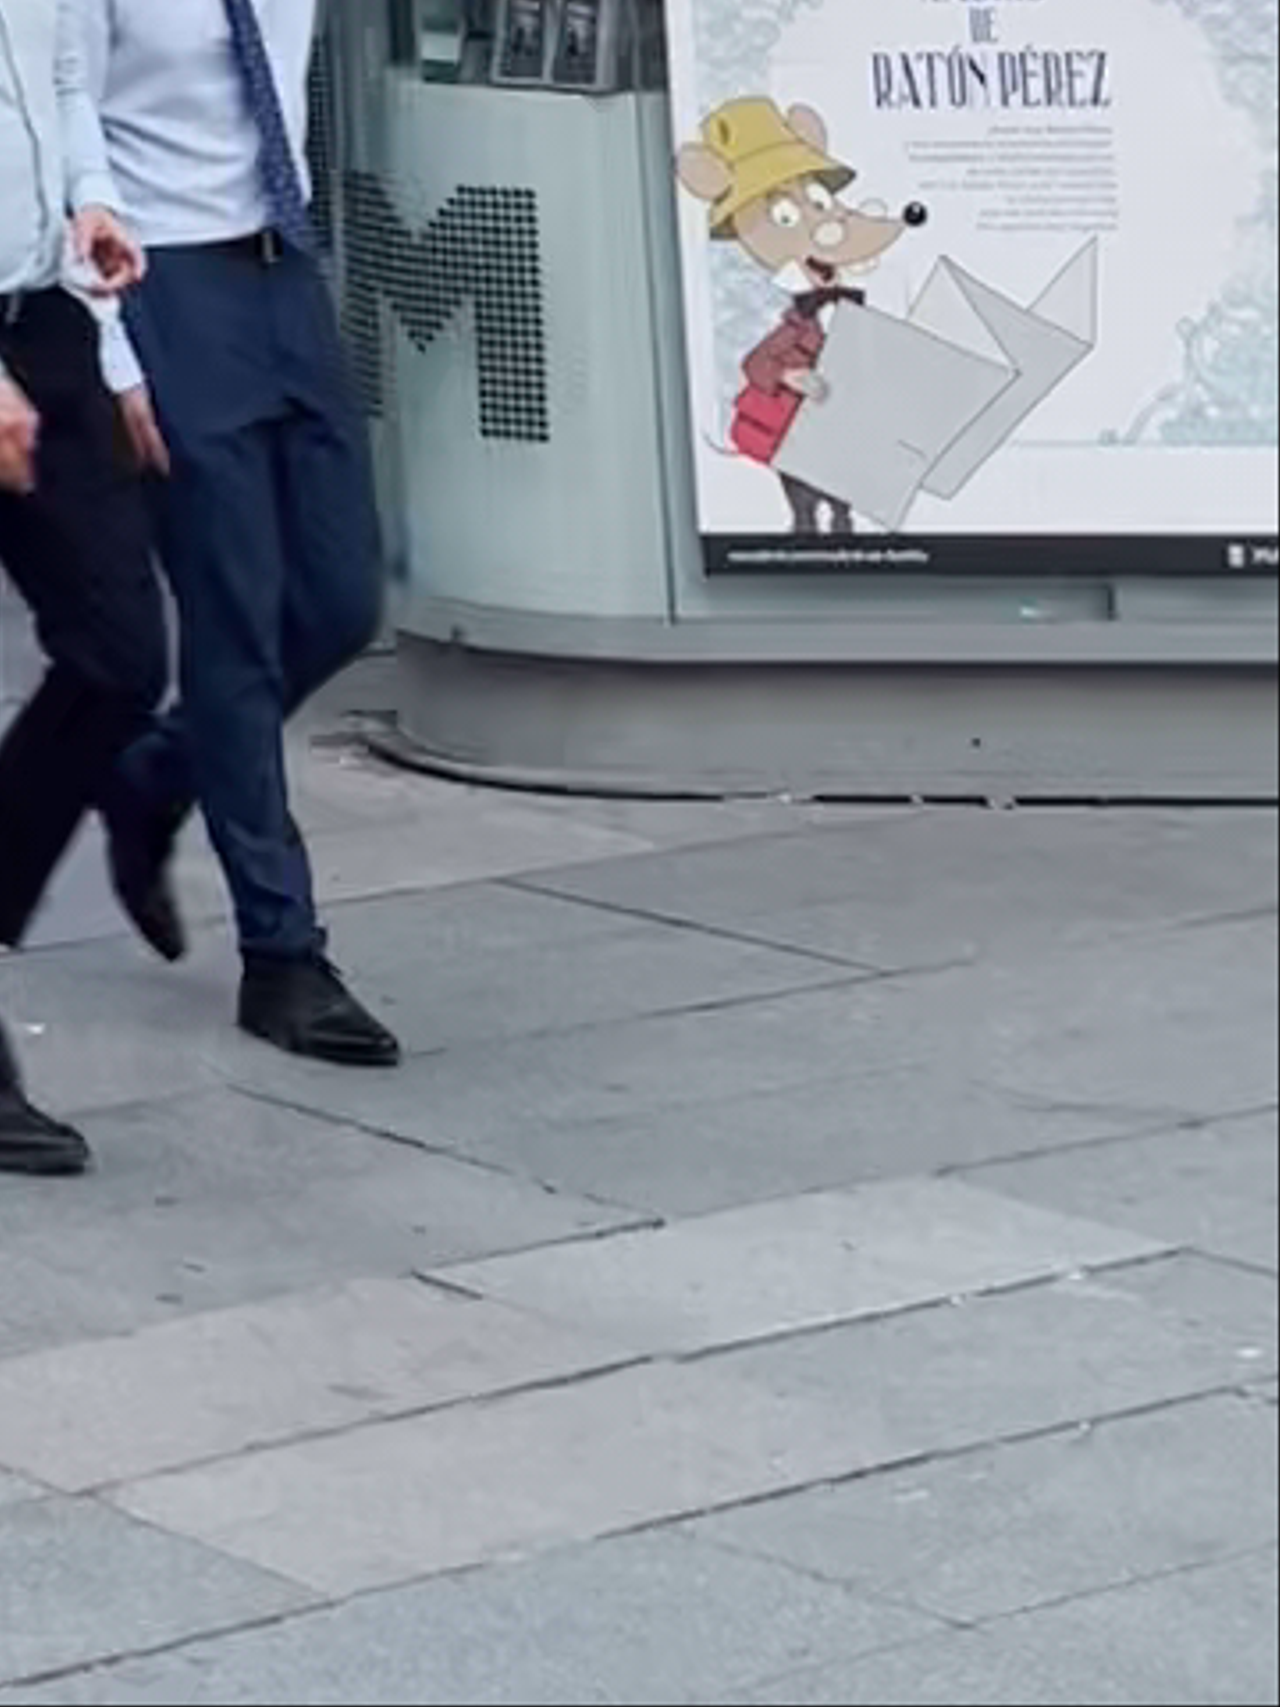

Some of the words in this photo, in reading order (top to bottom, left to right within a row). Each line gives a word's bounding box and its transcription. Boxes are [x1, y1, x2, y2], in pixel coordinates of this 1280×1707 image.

[969, 6, 999, 43] DE
[871, 45, 988, 109] RATÓN
[996, 45, 1112, 108] PÉREZ
